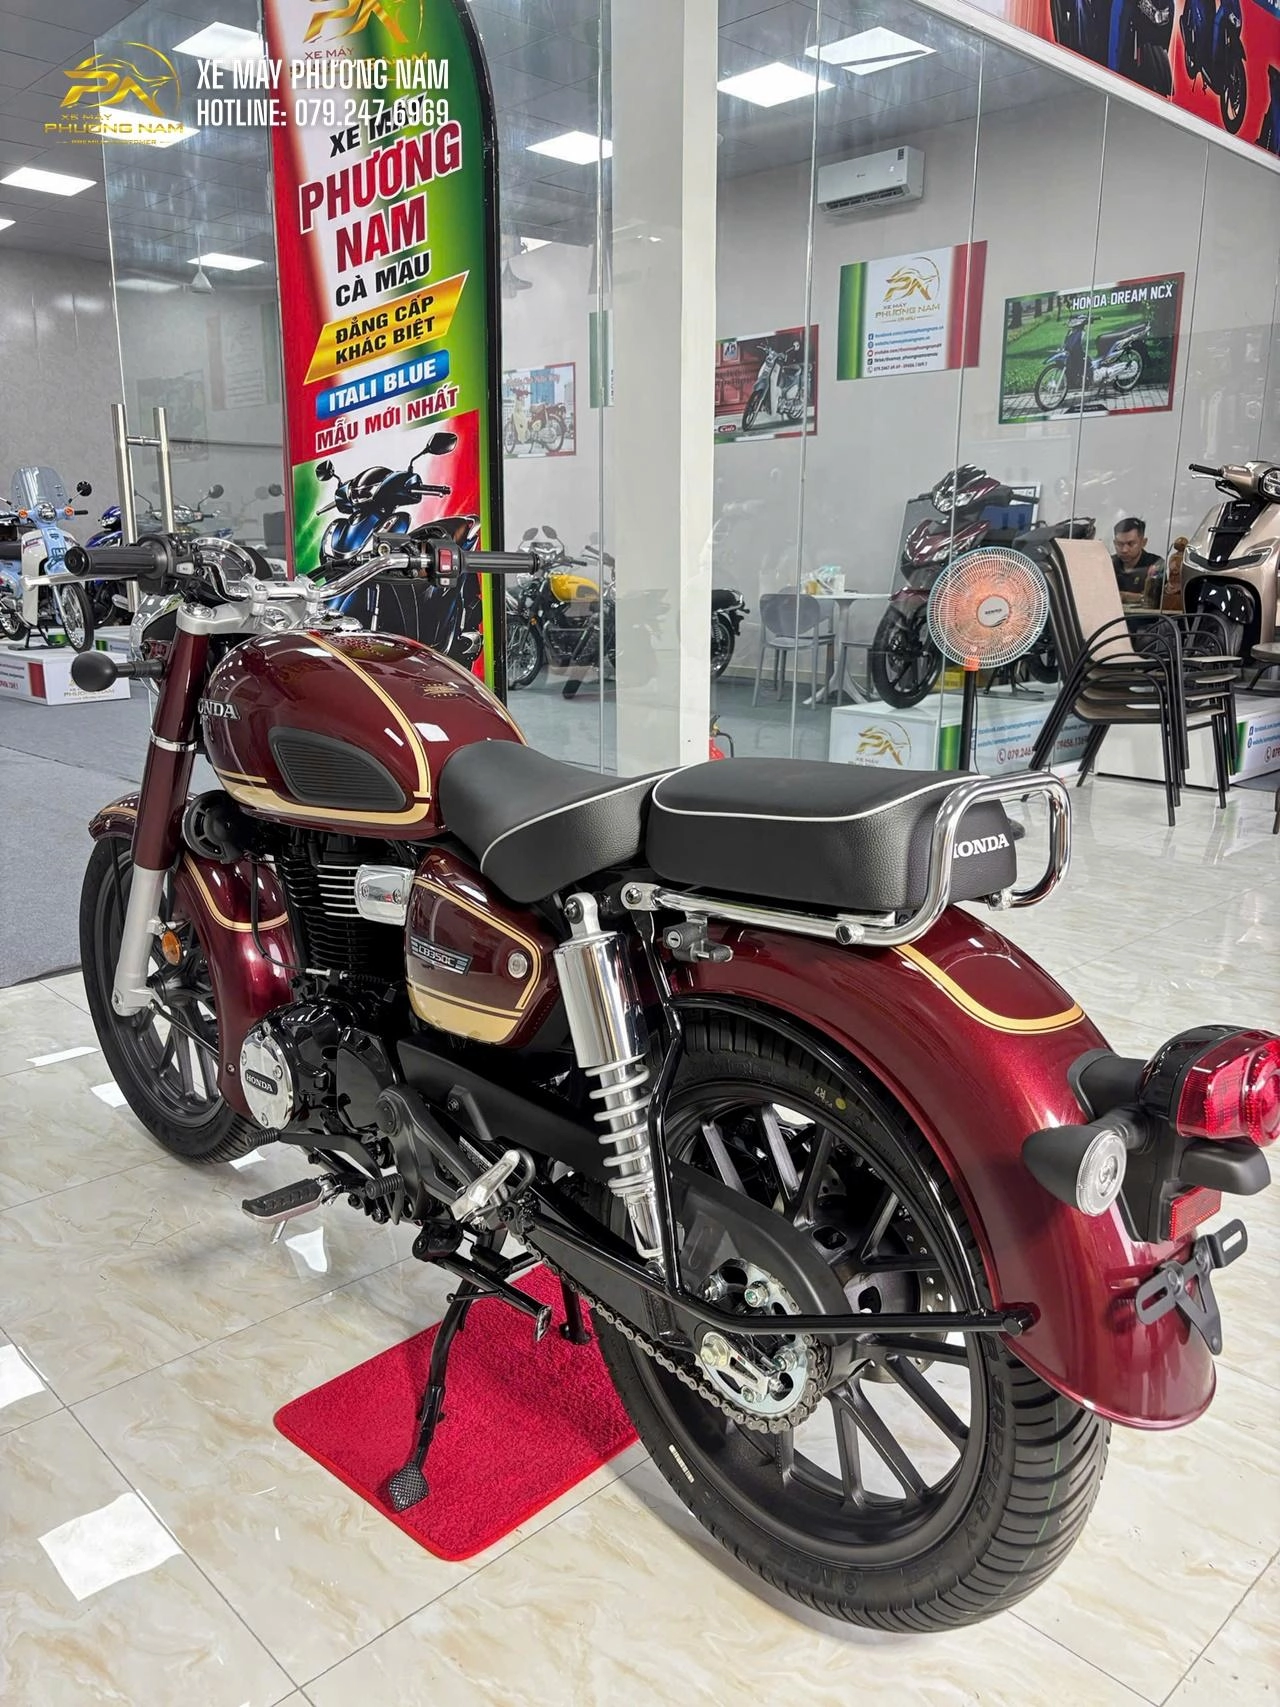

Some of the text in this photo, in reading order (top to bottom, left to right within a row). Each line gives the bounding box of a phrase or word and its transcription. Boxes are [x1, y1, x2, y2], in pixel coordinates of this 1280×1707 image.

[305, 46, 354, 60] XE MÁY
[330, 124, 360, 158] XE
[300, 122, 461, 231] PHƯƠNG
[336, 194, 426, 273] NAM
[336, 252, 430, 307] CÀ MAU
[1072, 284, 1173, 311] HONDA DREAM NCX
[395, 294, 434, 322] CẤP
[336, 316, 435, 365] KHÁC BIỆT
[329, 359, 437, 412] ITALI BLUE
[317, 383, 458, 450] MẪU MỚI NHẤT
[196, 698, 238, 720] ONDA
[245, 1073, 275, 1093] HONDA
